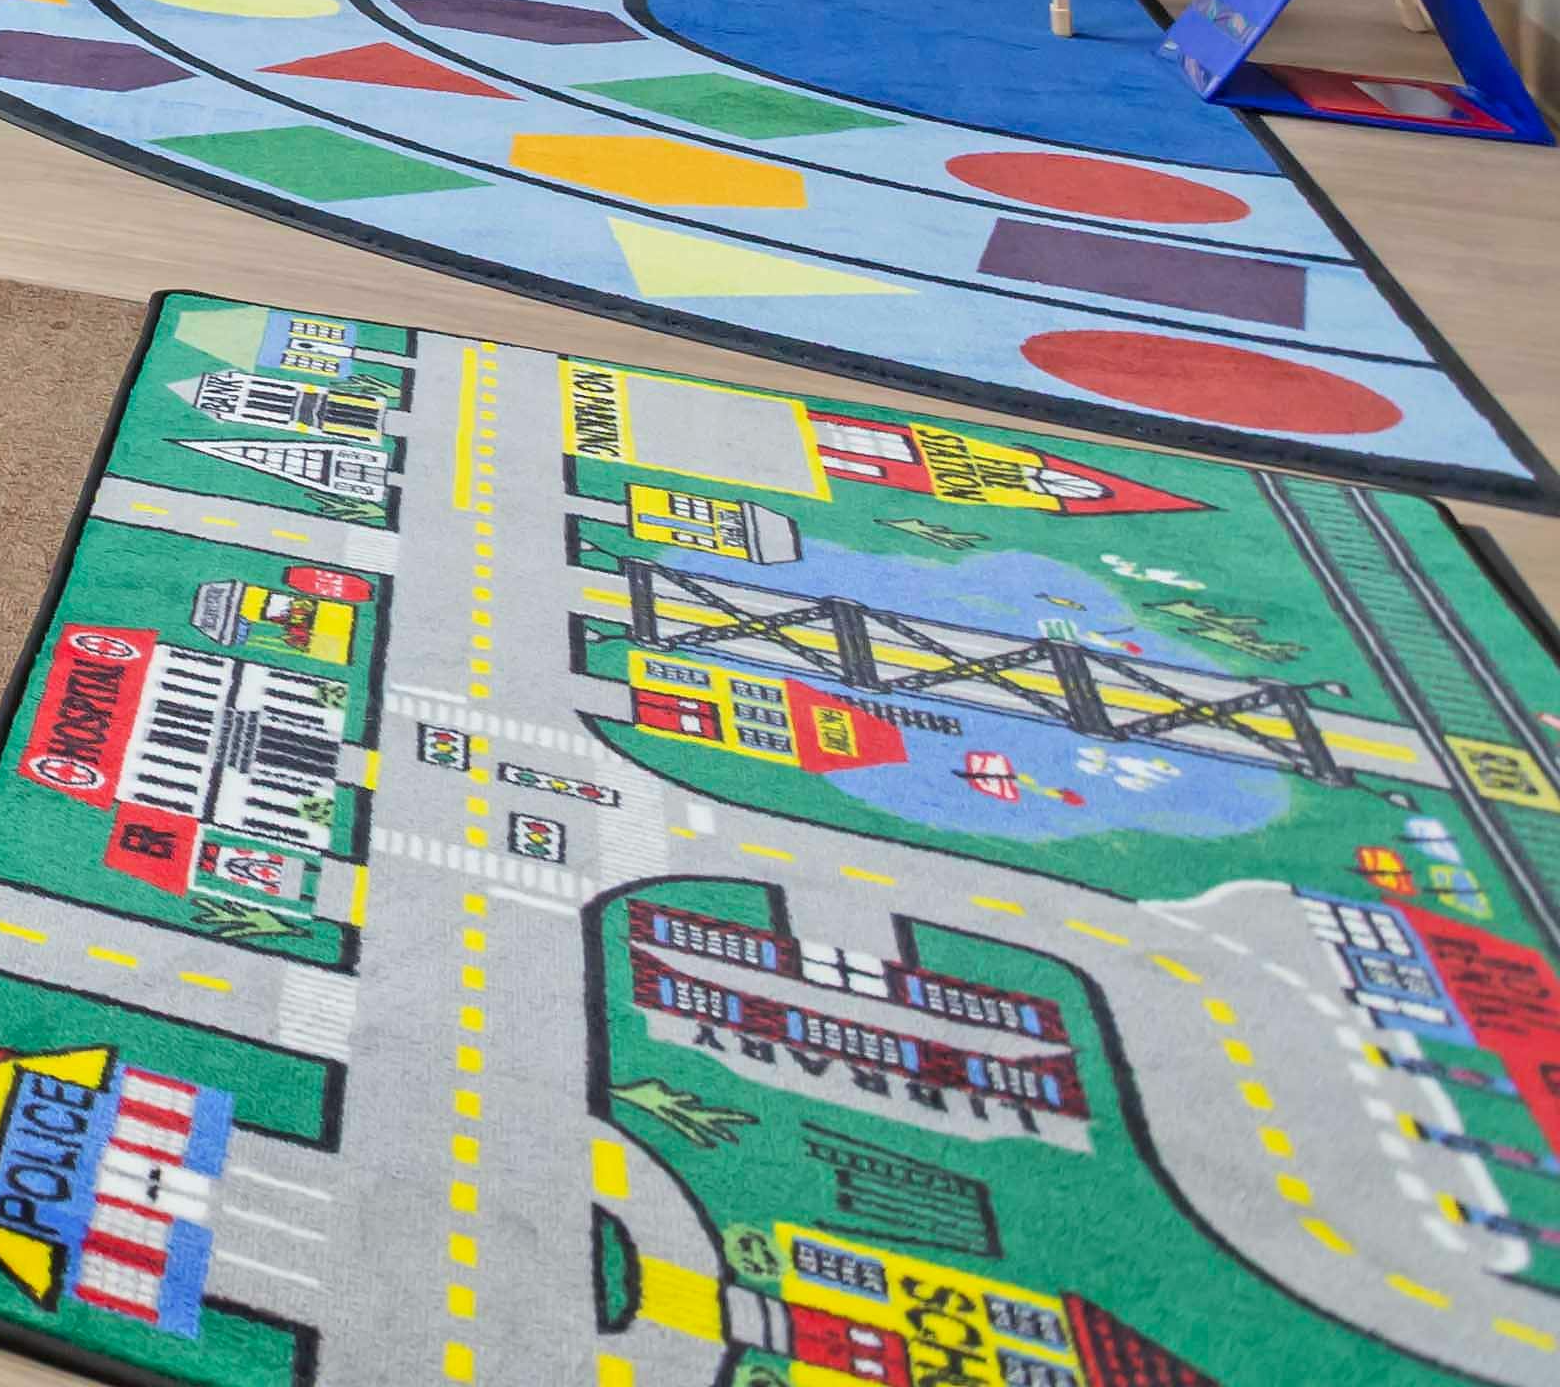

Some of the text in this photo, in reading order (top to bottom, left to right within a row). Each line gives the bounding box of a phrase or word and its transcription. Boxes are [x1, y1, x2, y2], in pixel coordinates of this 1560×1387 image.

[199, 375, 245, 414] BANK
[572, 368, 621, 457] NO PARKING
[917, 429, 988, 503] STATION
[47, 657, 125, 765] HOSPITAL
[120, 823, 177, 859] ER
[695, 1023, 1041, 1133] LIBRARY
